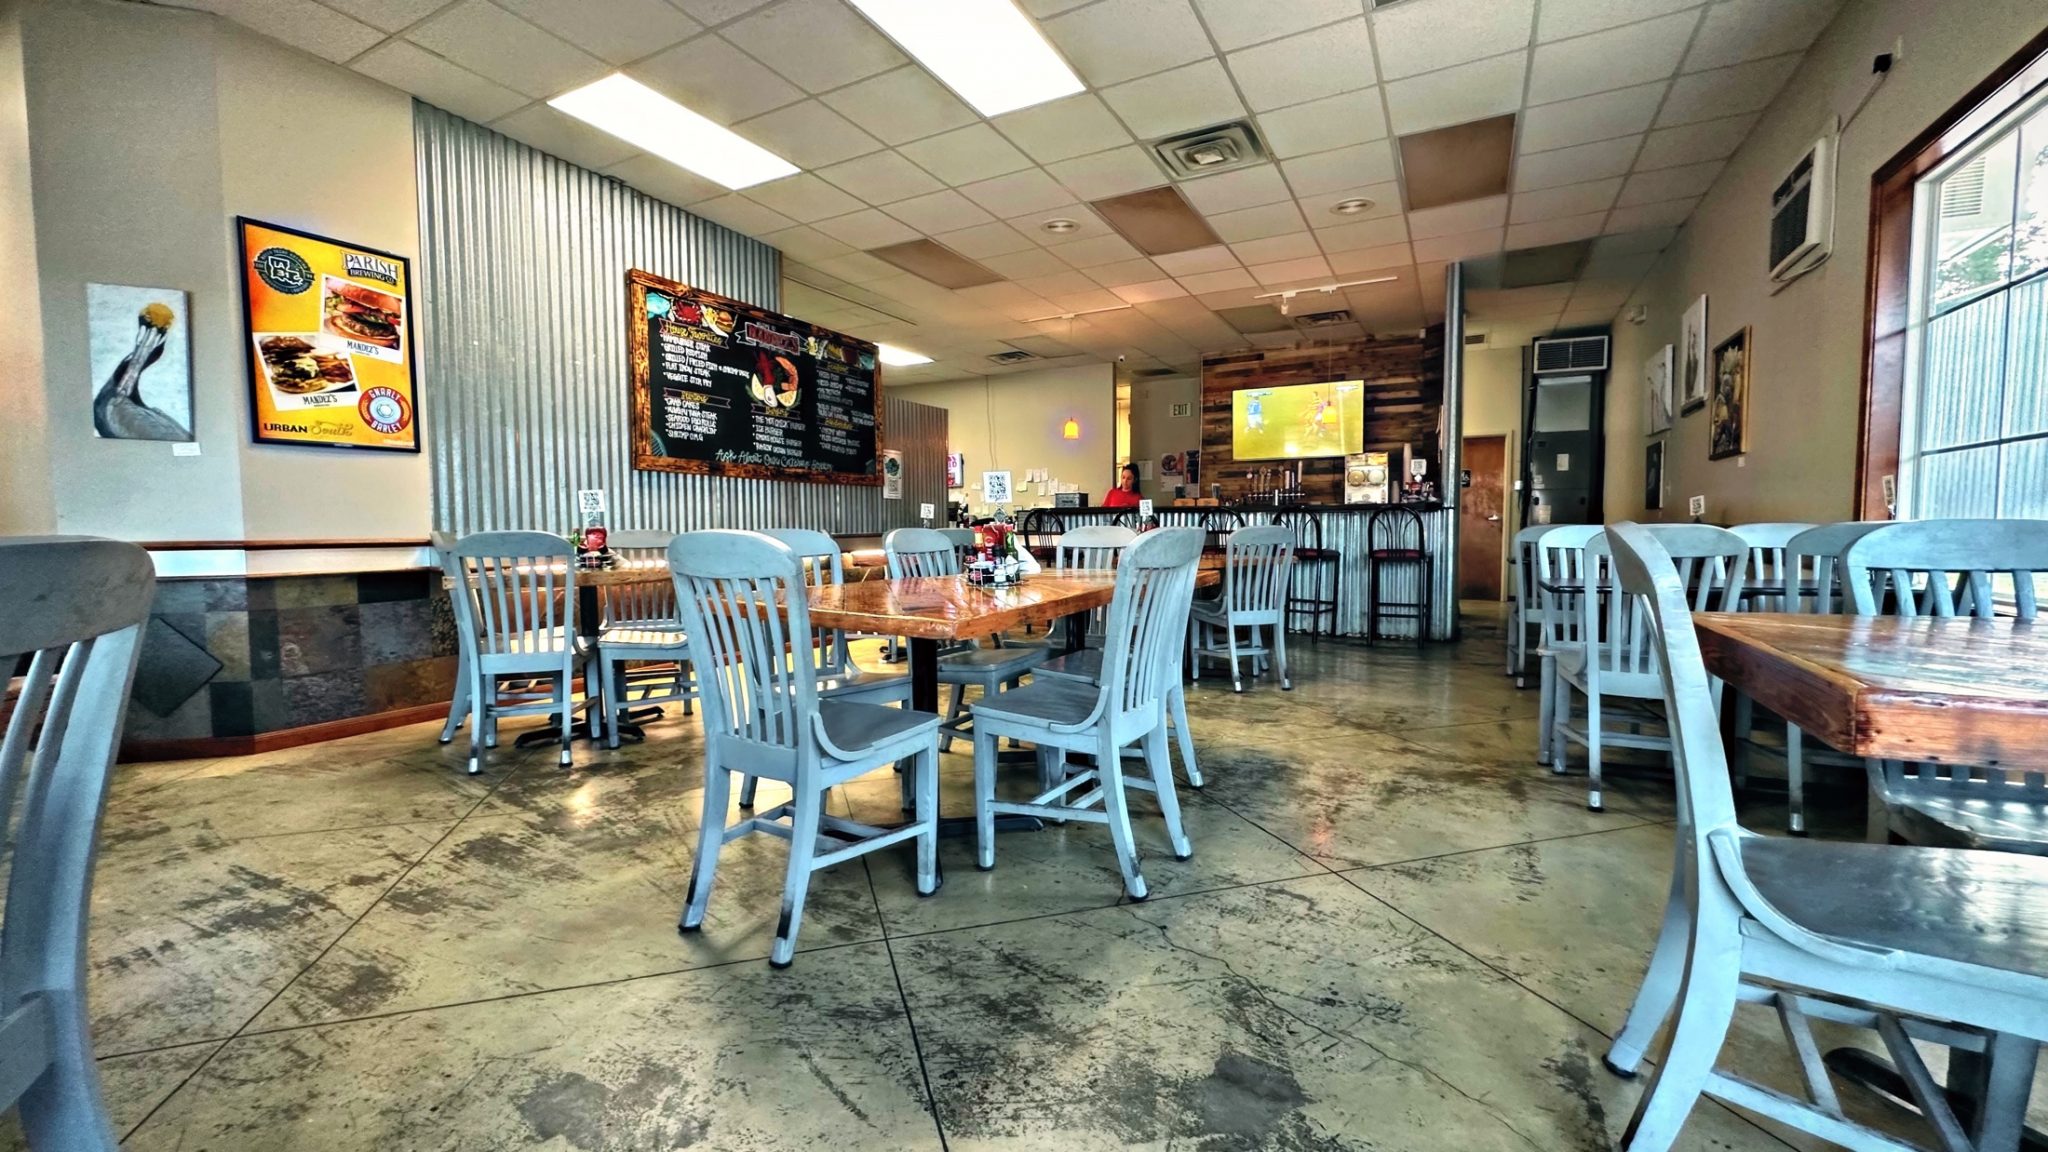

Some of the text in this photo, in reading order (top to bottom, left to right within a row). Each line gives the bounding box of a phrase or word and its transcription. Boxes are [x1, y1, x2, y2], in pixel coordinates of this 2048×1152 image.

[273, 261, 285, 270] LA
[344, 254, 398, 279] PARISH
[350, 268, 384, 281] BREWING
[665, 320, 689, 338] House
[347, 340, 379, 355] MANDEZ'S
[665, 361, 678, 371] FLAT
[693, 367, 712, 379] STEAK
[303, 393, 338, 405] MANDEZ'S
[368, 387, 401, 401] GNARLY
[1173, 403, 1189, 416] EXIT
[264, 420, 354, 437] URBAN South
[371, 420, 402, 434] BARLEY
